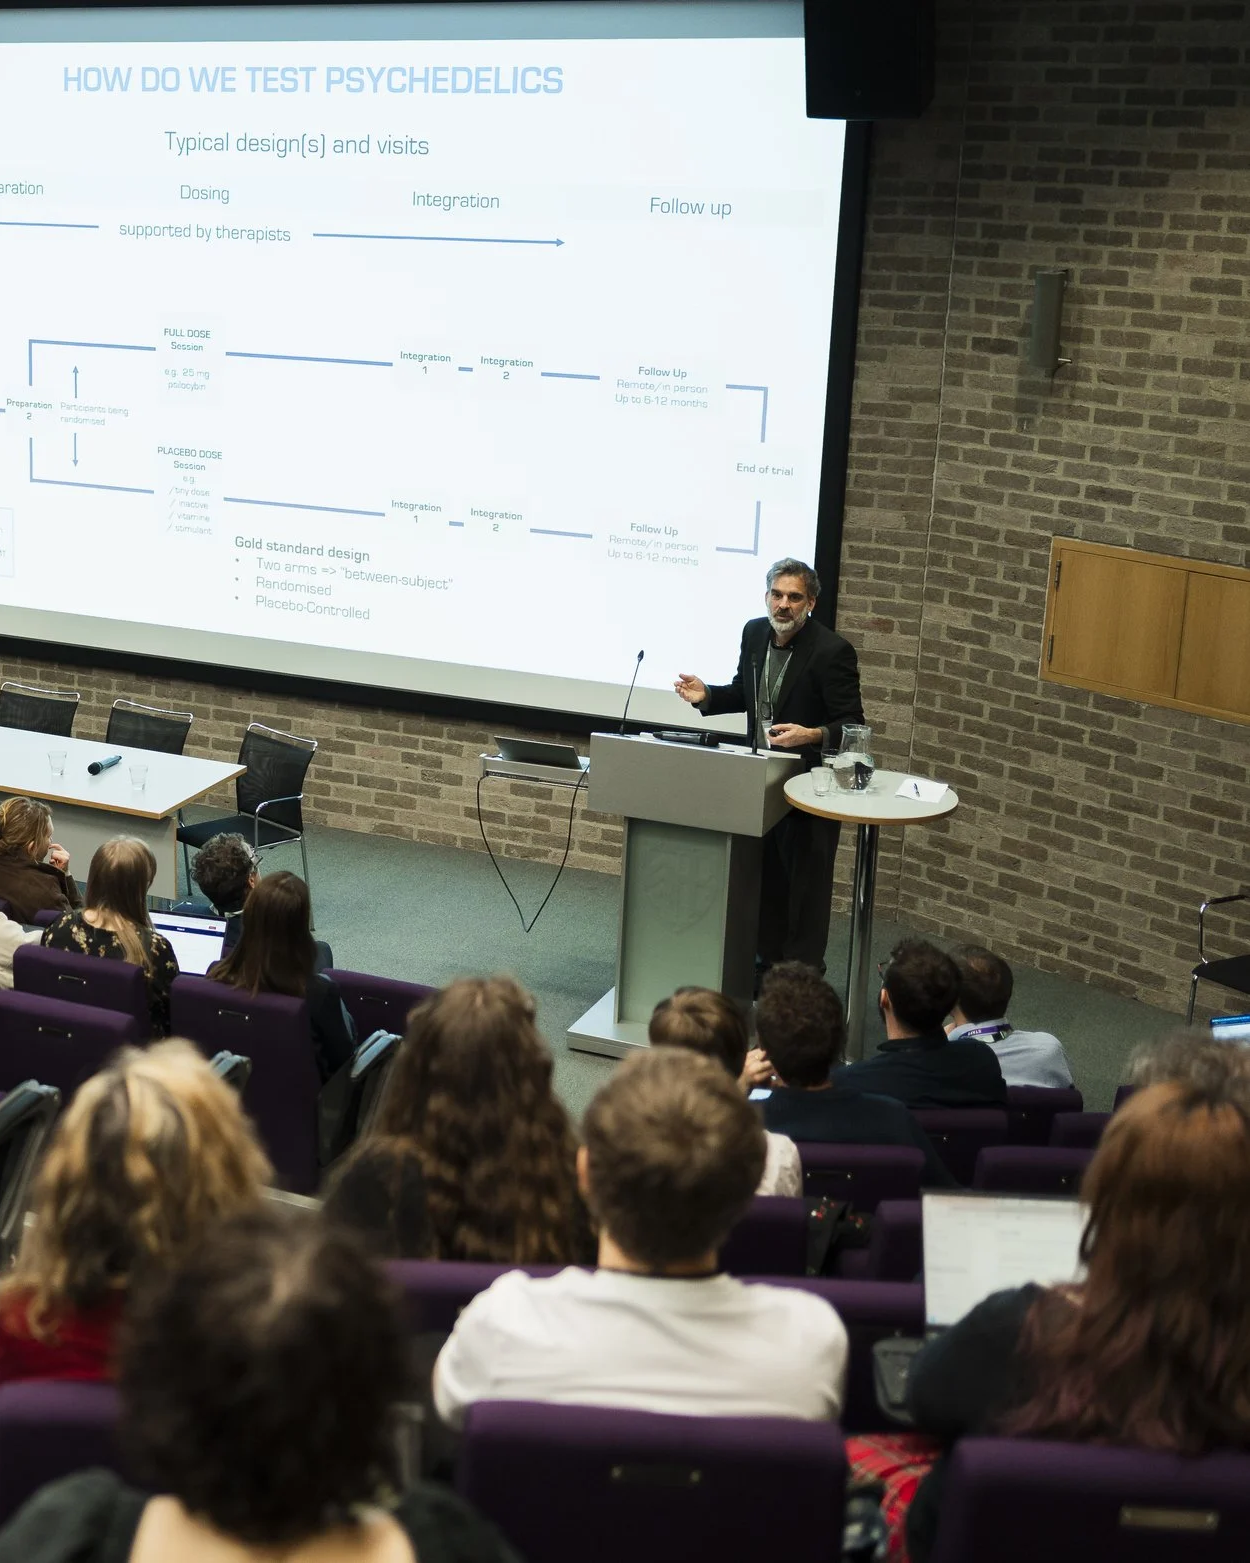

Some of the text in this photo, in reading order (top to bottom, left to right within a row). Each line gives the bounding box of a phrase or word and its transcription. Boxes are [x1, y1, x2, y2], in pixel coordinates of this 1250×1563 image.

[63, 66, 564, 94] HOW DO WE TEST PSYCHEDELICS
[165, 131, 430, 159] Typical design(s) and visits
[180, 185, 229, 204] Dosing
[412, 191, 500, 211] Integration
[650, 197, 732, 219] Follow up
[119, 223, 291, 244] supported by therapists
[164, 328, 211, 339] FULL DOSE
[171, 342, 203, 352] Session
[400, 351, 451, 362] Integration
[481, 356, 534, 368] Integration
[182, 368, 194, 378] 25
[196, 369, 209, 379] mg
[422, 366, 427, 374] 1
[503, 372, 510, 380] 2
[638, 366, 687, 379] Follow Up
[168, 381, 206, 391] psilocybin
[617, 379, 708, 394] Remote/in person
[7, 399, 52, 410] Preparation
[615, 394, 708, 408] Up to 6-12 months
[60, 401, 128, 416] Participants being
[60, 415, 105, 425] randomised
[158, 447, 222, 459] PLACEBO DOSE
[174, 461, 206, 471] Session
[736, 463, 793, 476] End of trial
[391, 500, 441, 513] Integration
[414, 515, 418, 523] 1
[471, 508, 522, 521] Integration
[493, 524, 499, 532] 2
[630, 523, 678, 537] Follow Up
[235, 536, 370, 563] Gold standard design
[665, 541, 698, 552] person
[607, 548, 698, 566] Up to 6-12 months
[257, 558, 281, 570] Two
[285, 563, 316, 575] arms
[256, 576, 331, 595] Randomised
[256, 595, 370, 620] Placebo-Controlled
